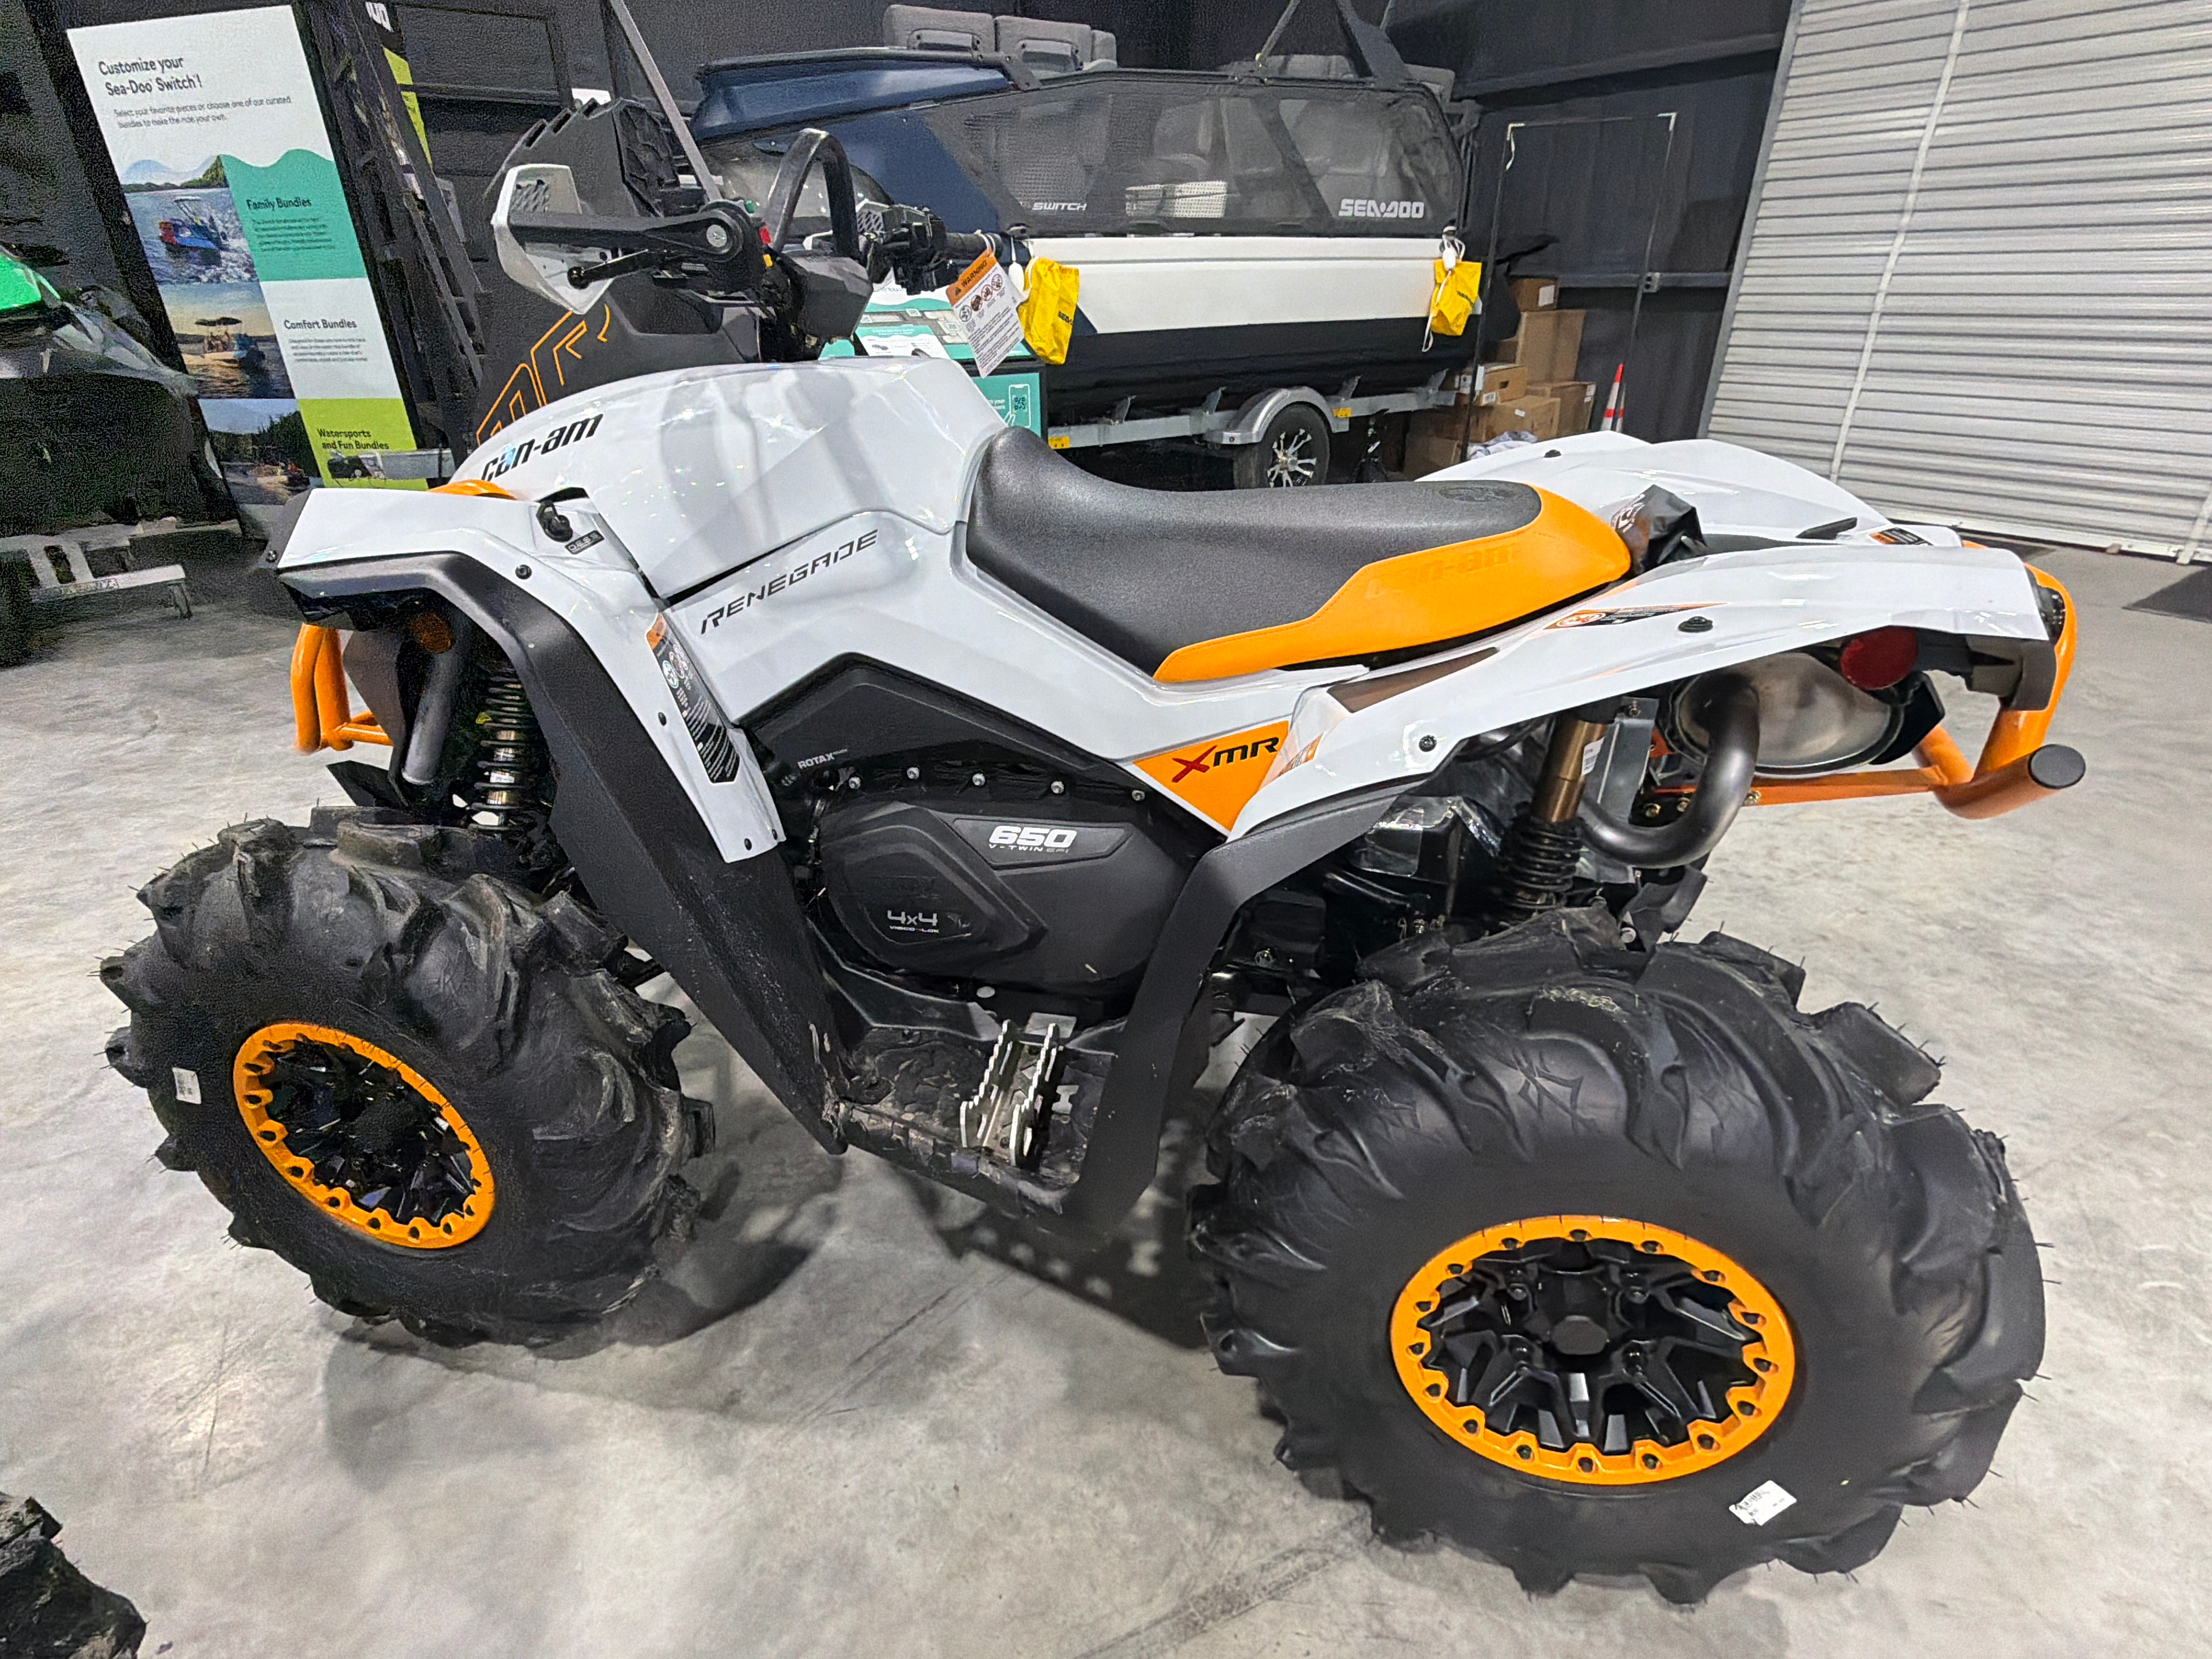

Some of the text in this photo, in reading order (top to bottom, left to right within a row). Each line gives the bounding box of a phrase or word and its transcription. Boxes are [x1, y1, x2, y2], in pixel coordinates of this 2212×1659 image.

[99, 57, 184, 75] Customize your
[246, 197, 312, 211] Family Bundles
[1032, 202, 1087, 211] SWITCH
[961, 260, 988, 288] WARNING
[284, 318, 358, 329] Comfort Bundles
[317, 428, 371, 439] Watersports
[322, 440, 390, 449] and Fun Bundles
[481, 414, 604, 481] can-am
[701, 529, 878, 635] RENEGADE
[797, 752, 835, 769] ROTAX
[989, 825, 1077, 848] 650
